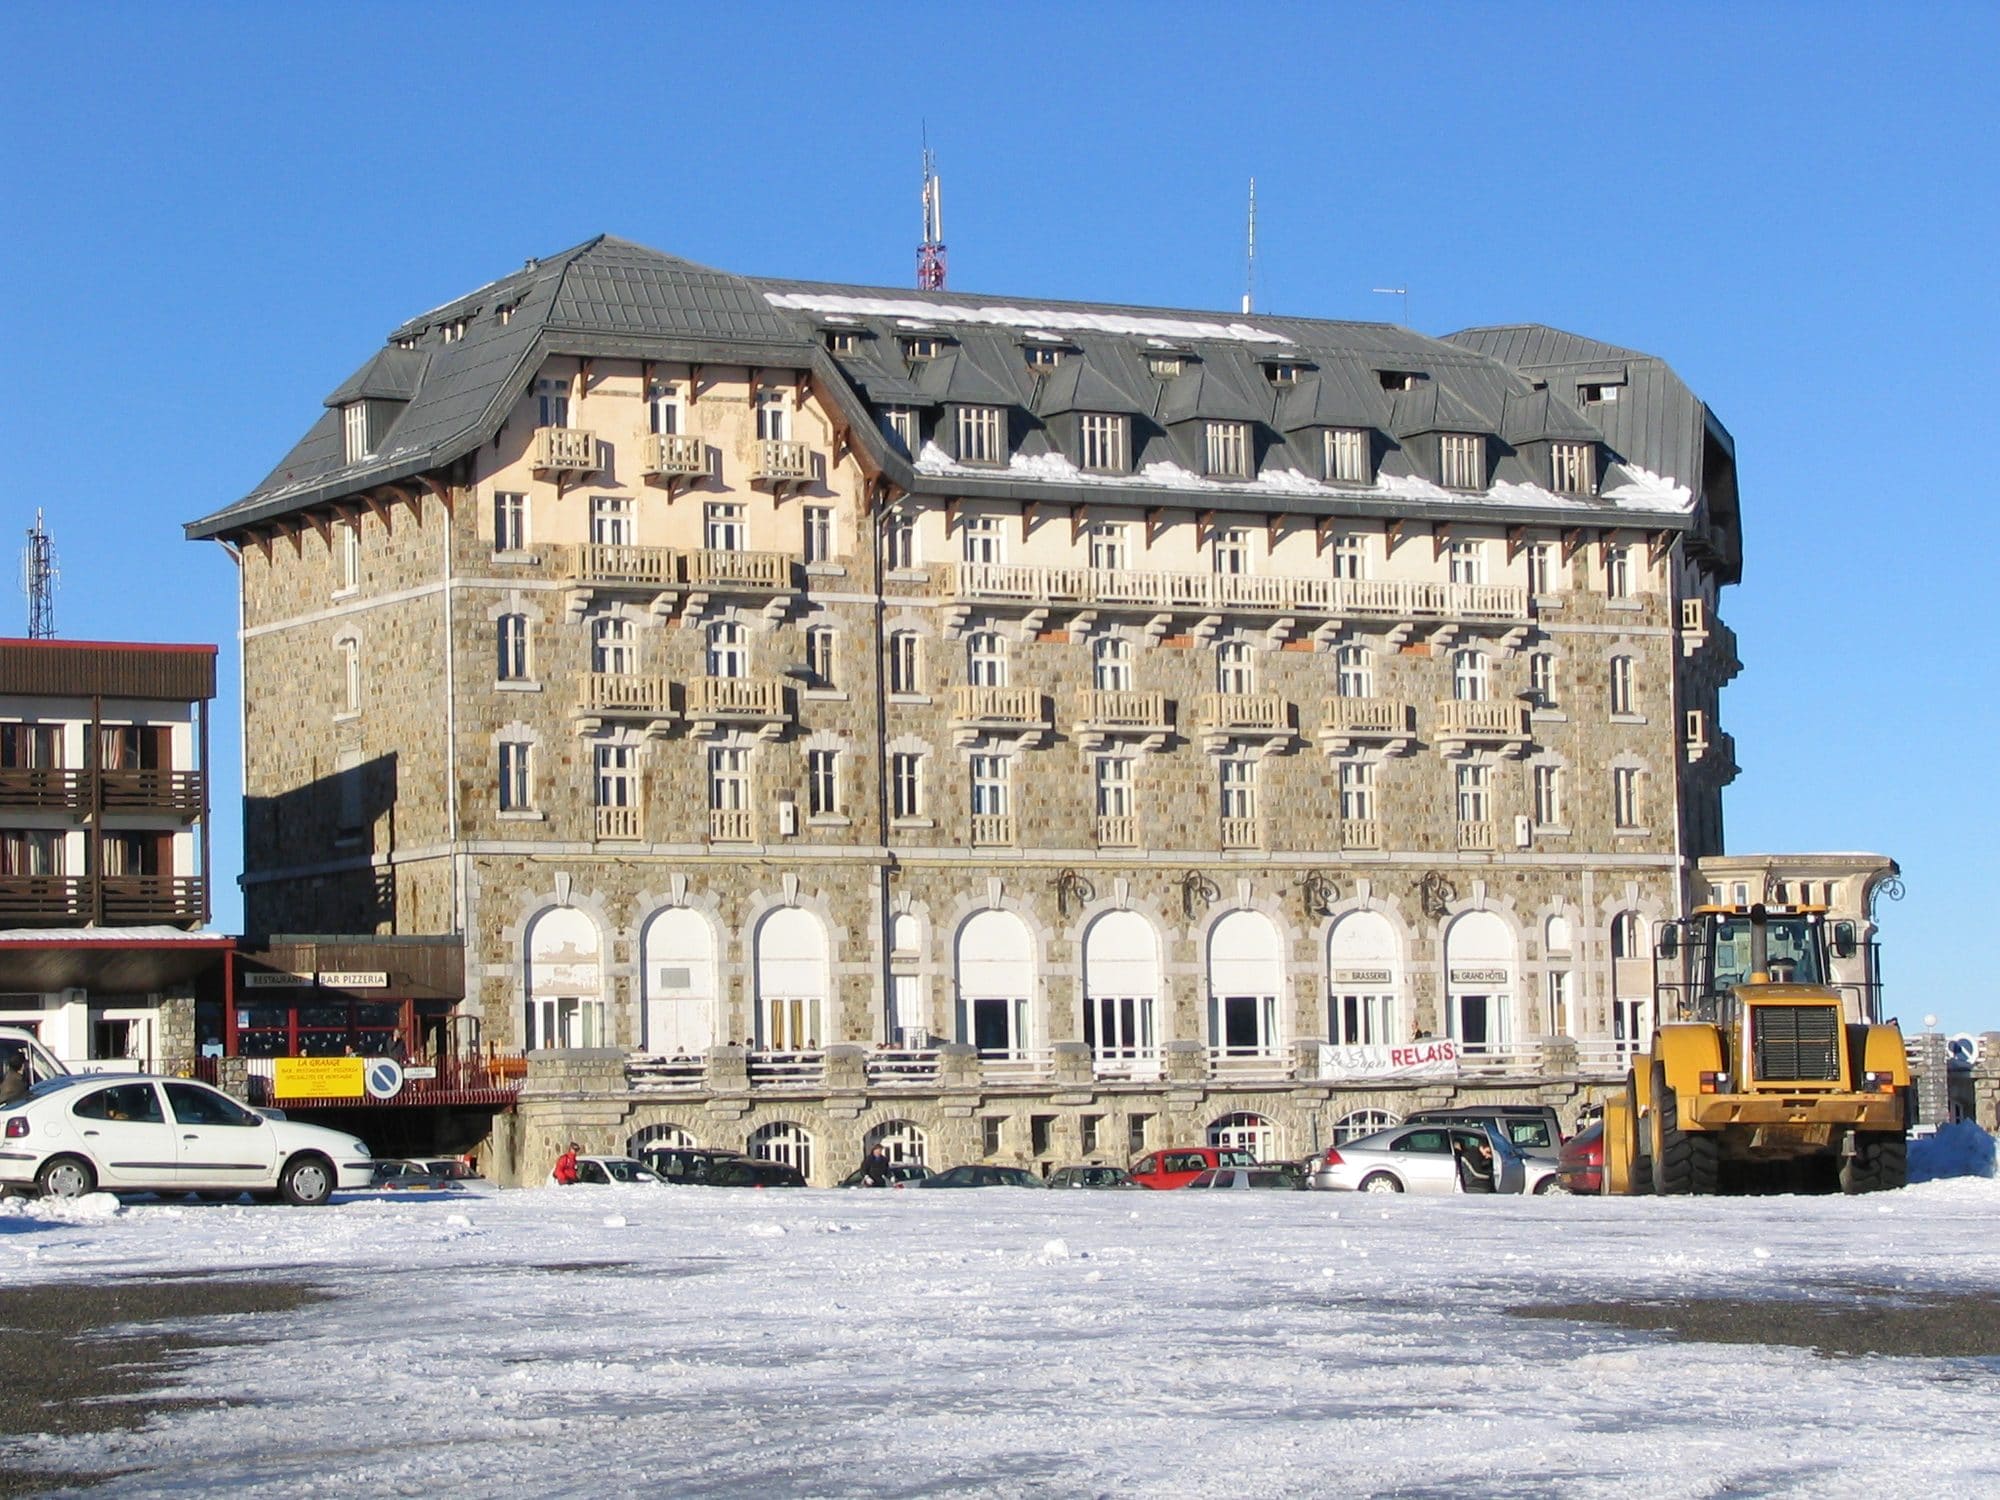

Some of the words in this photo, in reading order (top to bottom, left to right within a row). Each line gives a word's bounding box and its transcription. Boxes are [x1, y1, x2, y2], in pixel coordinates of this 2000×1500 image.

[320, 975, 341, 984] BAR
[343, 974, 384, 984] PIZZERIA
[1352, 972, 1387, 980] BRASSERIE
[1461, 972, 1484, 980] GRAND
[1485, 969, 1505, 980] HÔTEL
[253, 975, 303, 984] RESTAURANT
[1391, 1042, 1454, 1067] RELAIS
[297, 1059, 307, 1067] LA
[309, 1059, 340, 1067] GRANGE
